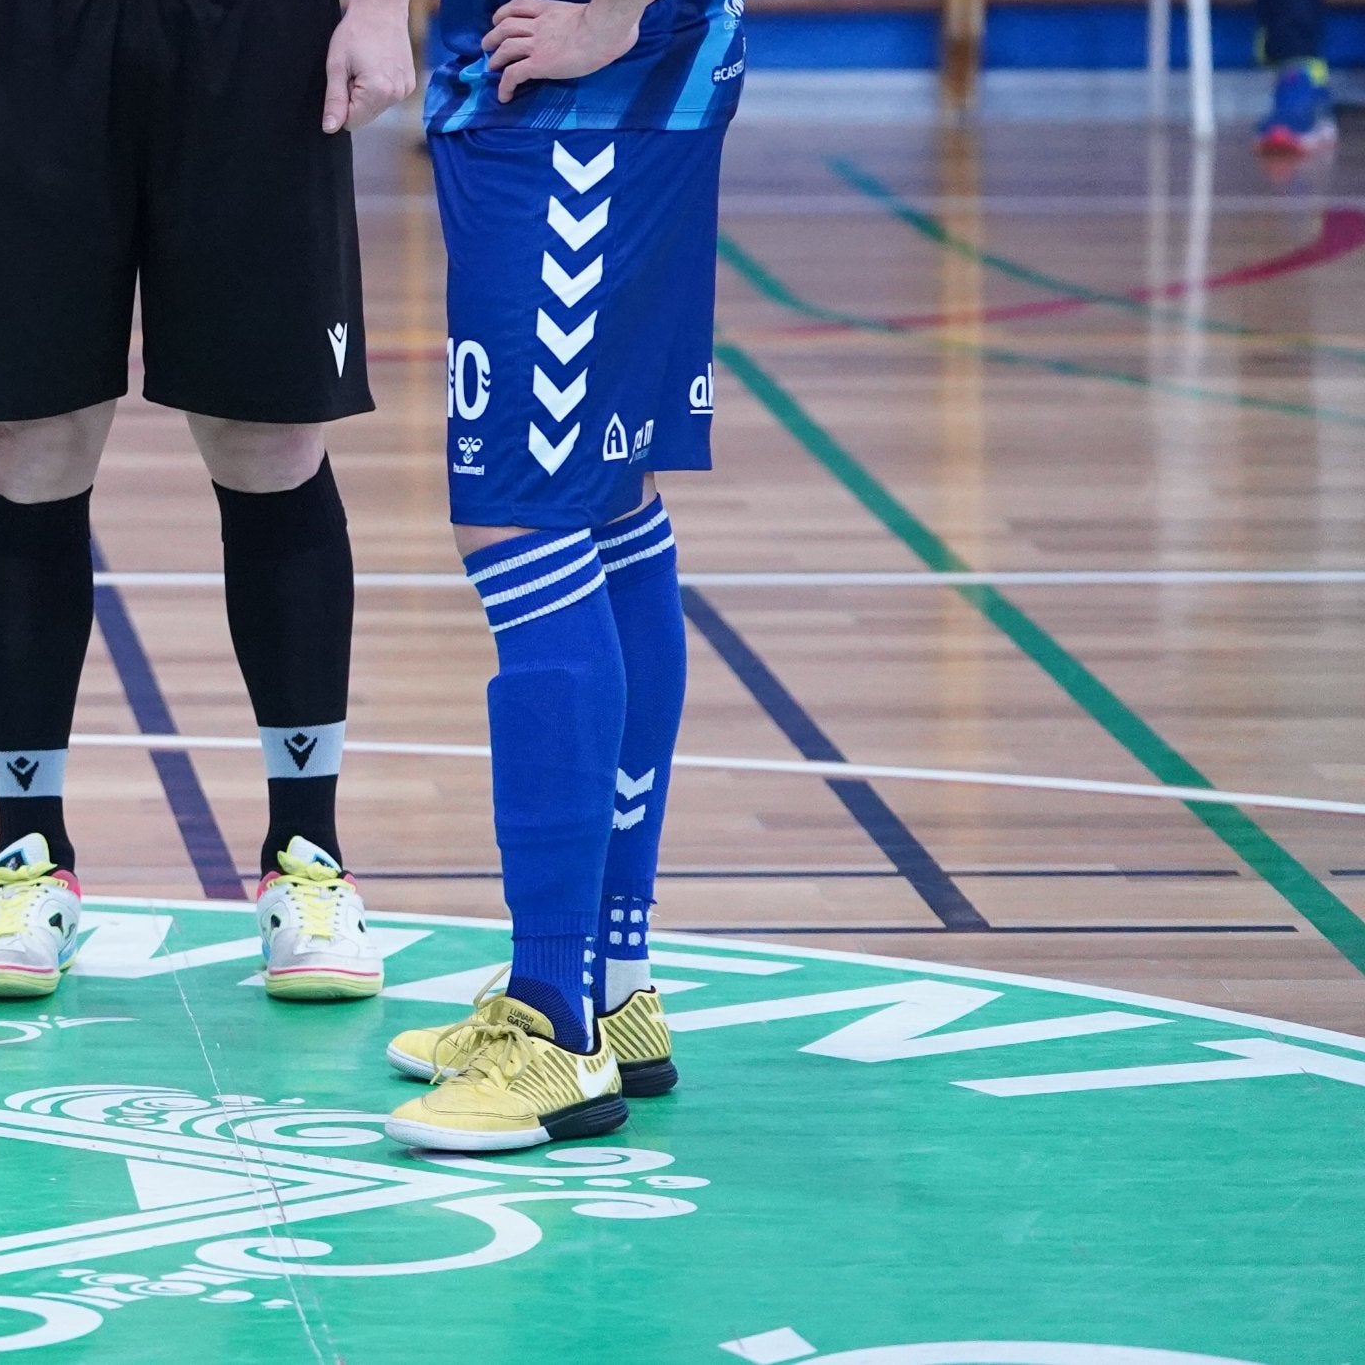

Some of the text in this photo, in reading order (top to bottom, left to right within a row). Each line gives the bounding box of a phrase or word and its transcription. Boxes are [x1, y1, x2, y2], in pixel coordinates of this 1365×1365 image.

[453, 462, 485, 476] hummel
[506, 1014, 531, 1032] GATO
[509, 1007, 535, 1026] LUNAR
